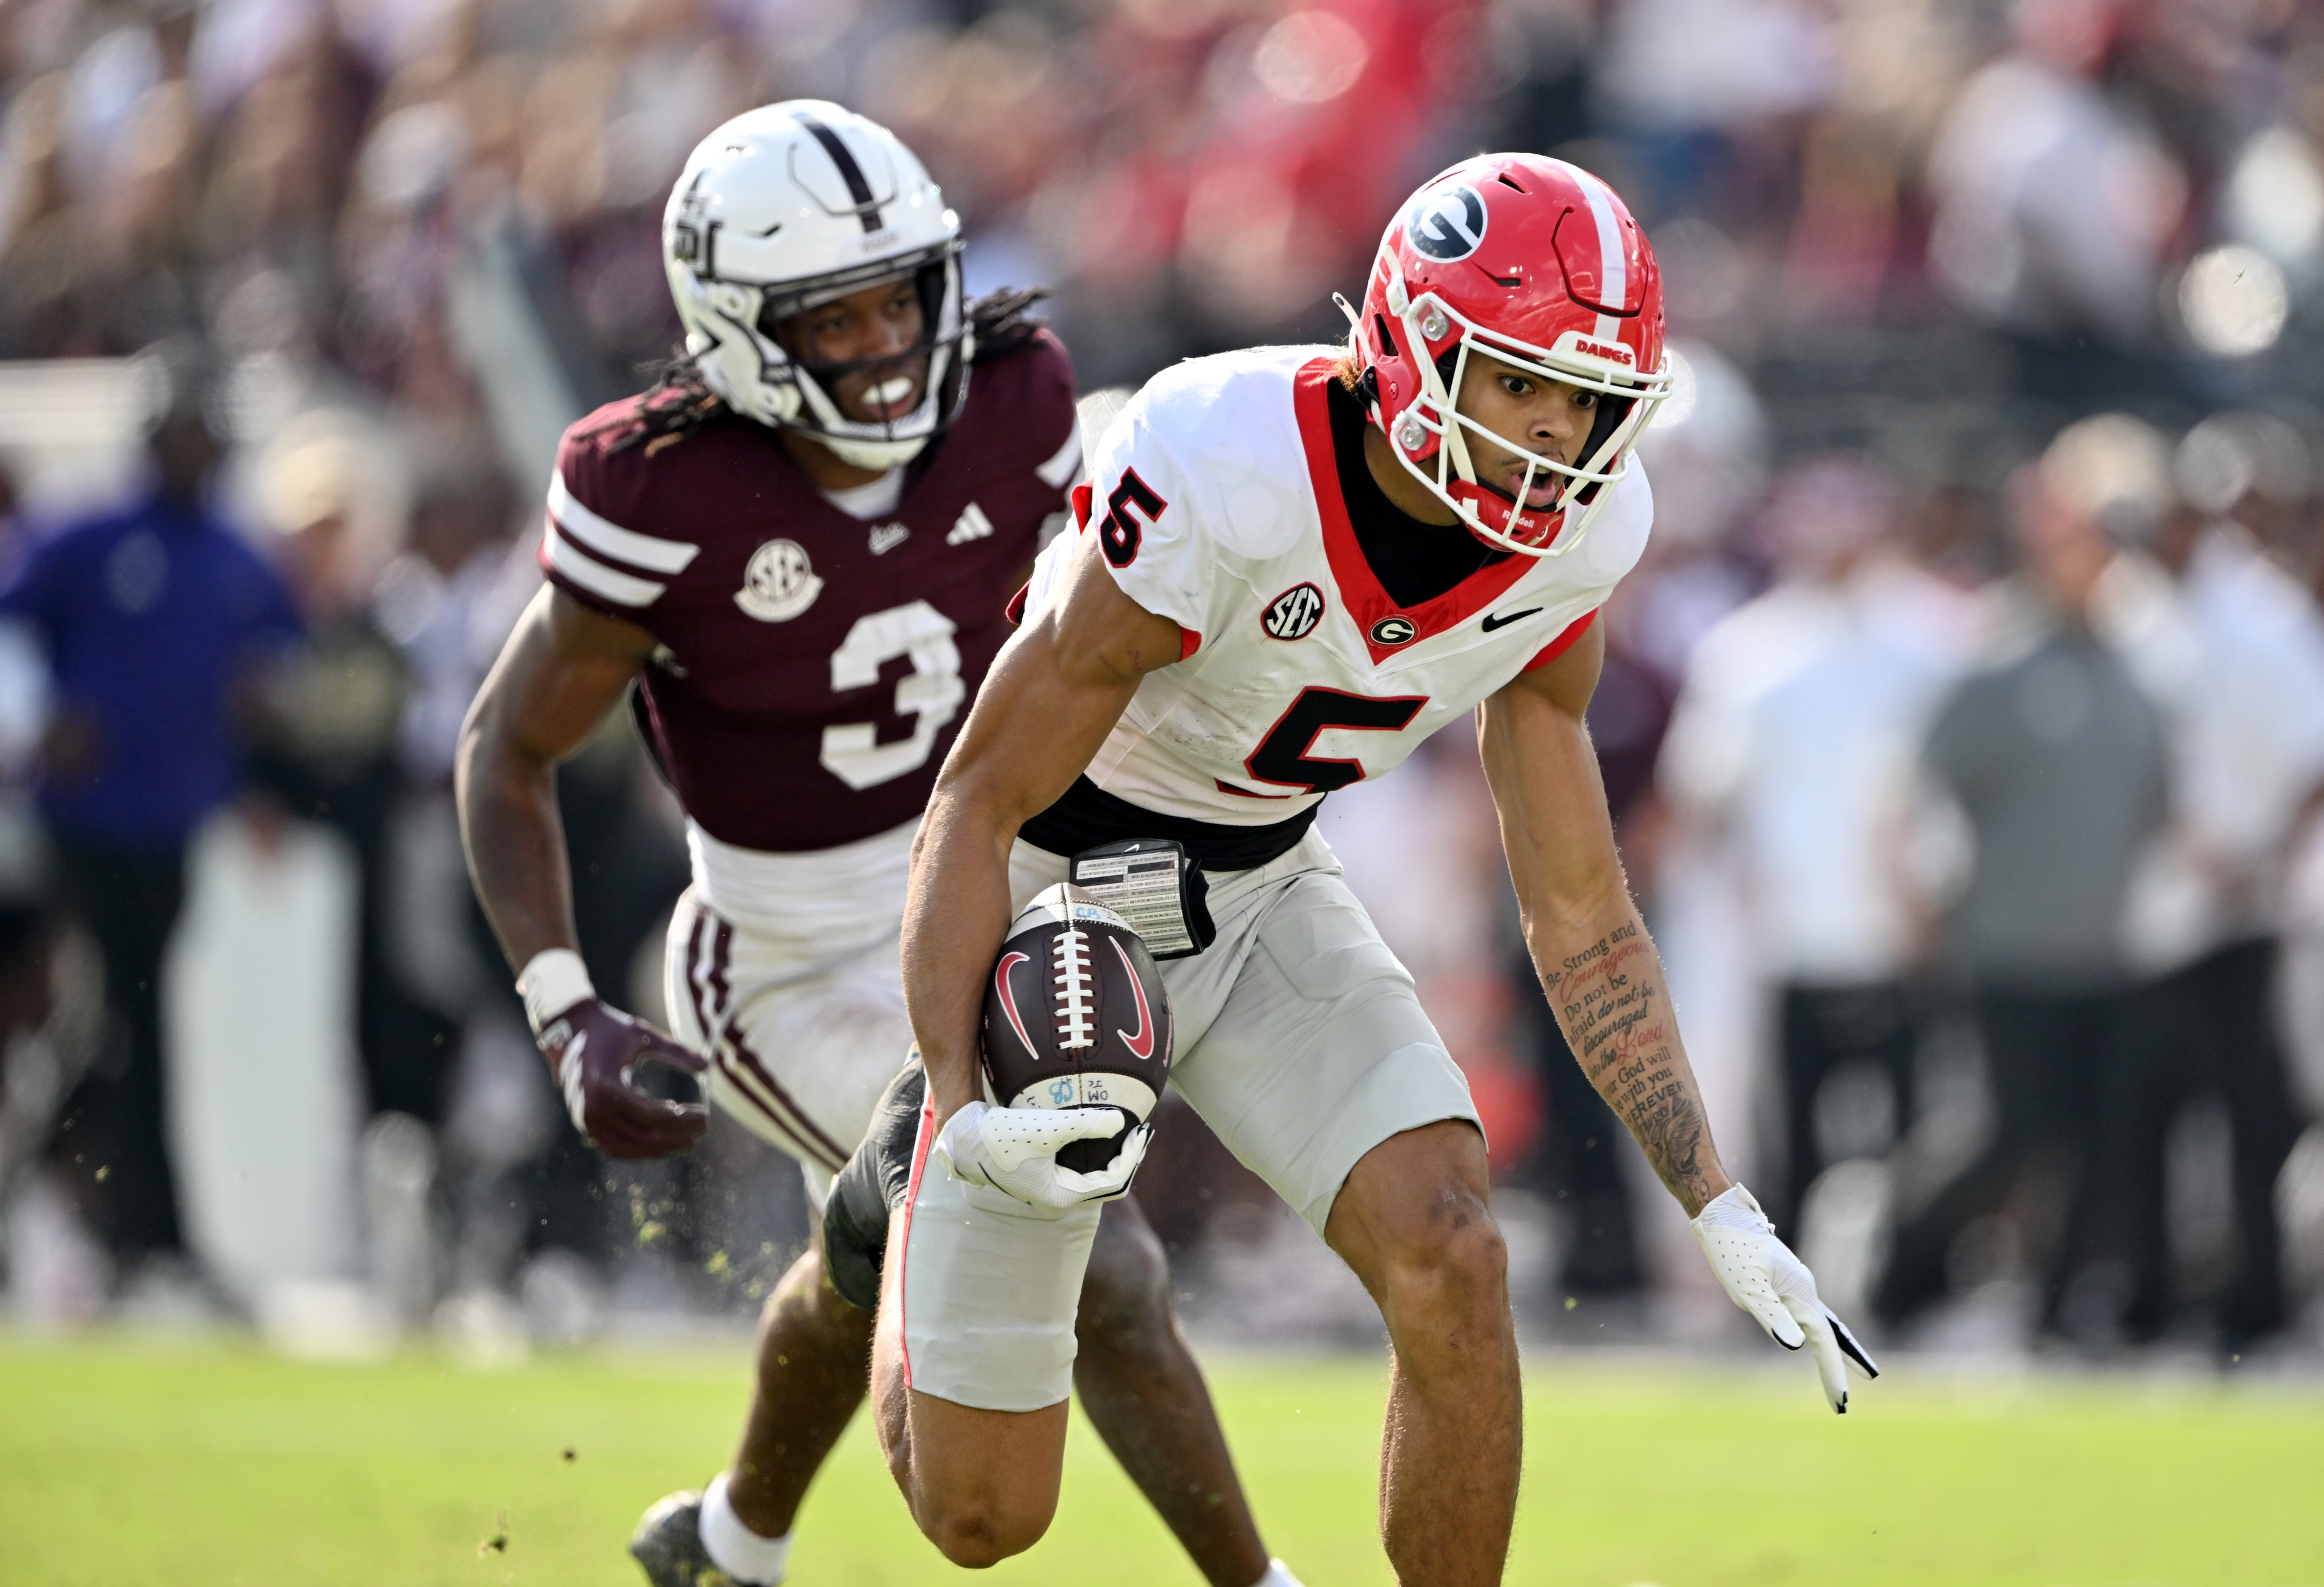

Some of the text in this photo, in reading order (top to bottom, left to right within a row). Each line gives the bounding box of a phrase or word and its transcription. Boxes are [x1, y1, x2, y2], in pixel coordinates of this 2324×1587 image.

[1408, 186, 1484, 259] G
[1575, 338, 1632, 365] DAWGS
[1100, 465, 1168, 568] 5
[1502, 510, 1535, 528] Rdell
[751, 544, 804, 597] SEC
[1267, 587, 1321, 637] SEC
[1371, 619, 1414, 645] G
[819, 599, 966, 791] 3
[1214, 685, 1431, 799] 5
[1545, 920, 1637, 990] Be Strong and
[1564, 974, 1627, 1023] Do not be
[1598, 1000, 1614, 1020] do
[1617, 985, 1639, 1008] not
[1641, 981, 1655, 998] be
[1584, 1000, 1647, 1057] discouraged
[1600, 1048, 1617, 1070] the
[1618, 1057, 1645, 1083] God
[1646, 1046, 1672, 1066] will
[1621, 1079, 1646, 1103] with
[1647, 1068, 1673, 1089] you
